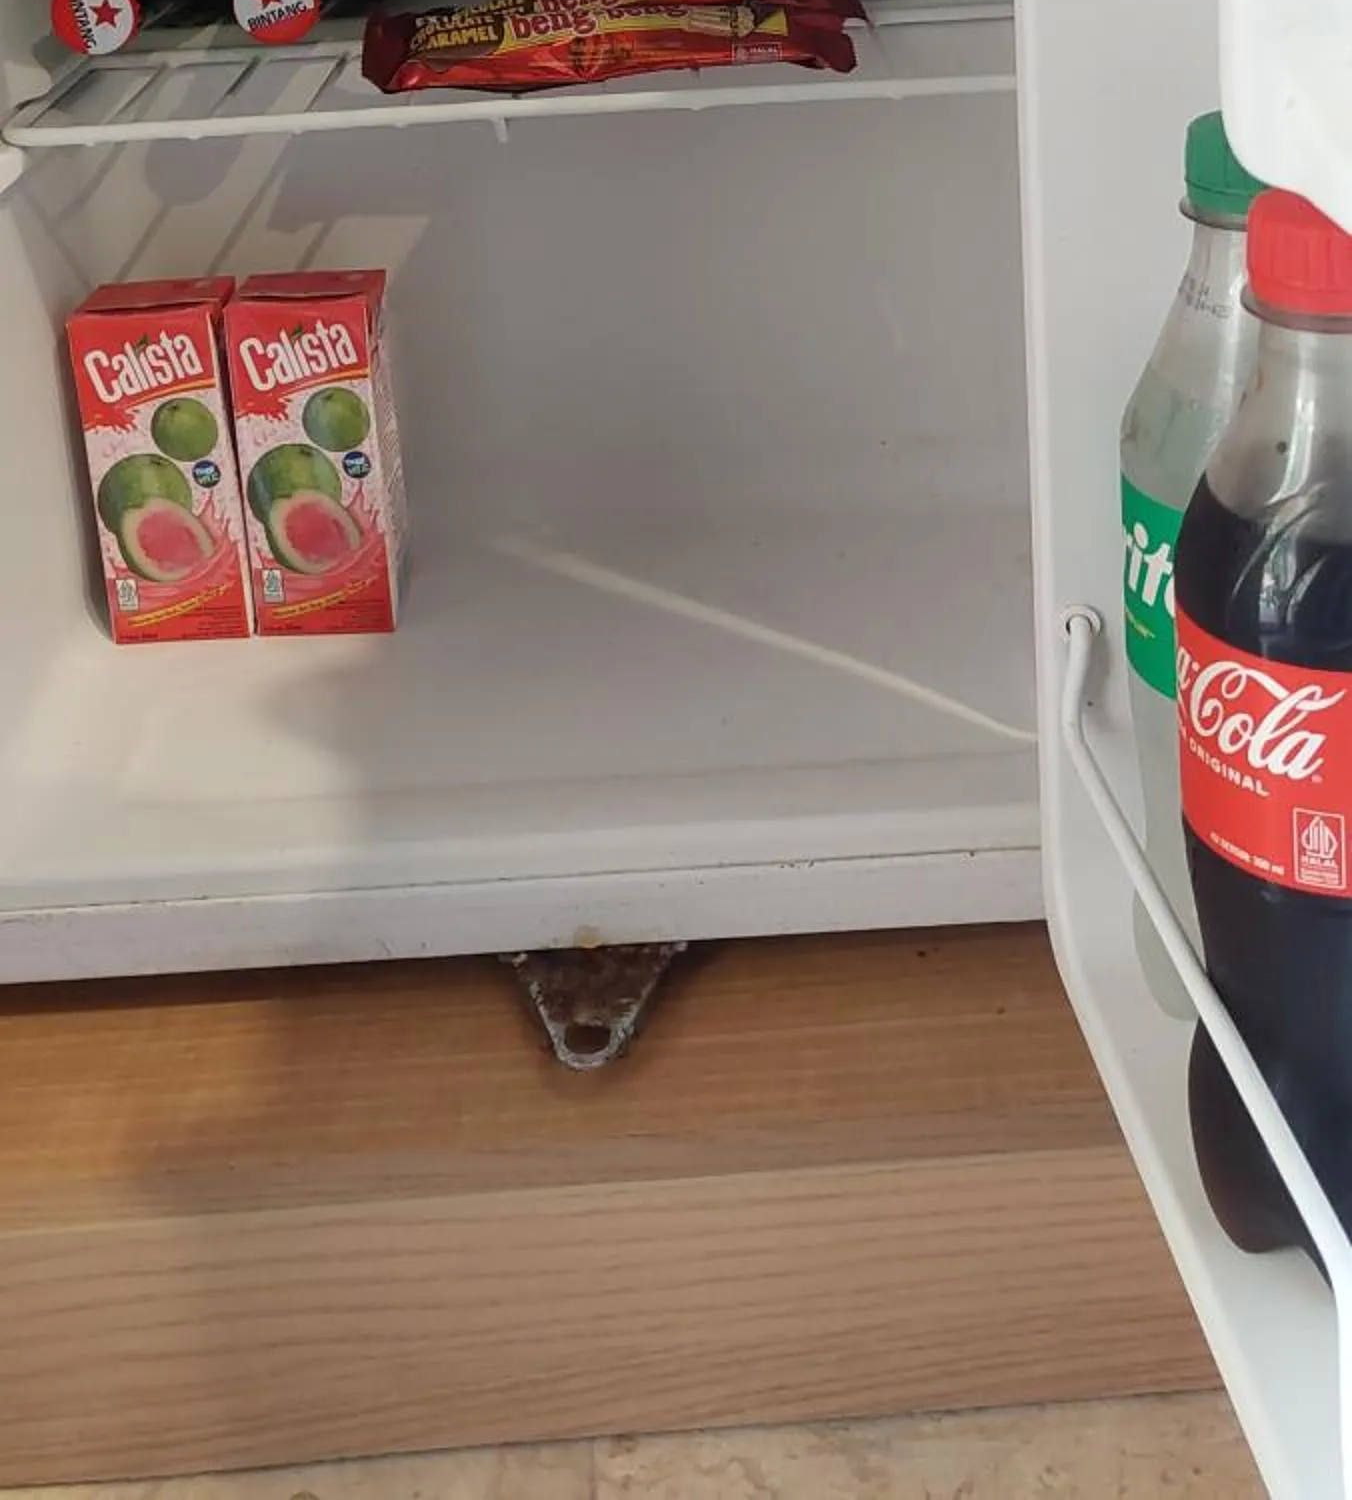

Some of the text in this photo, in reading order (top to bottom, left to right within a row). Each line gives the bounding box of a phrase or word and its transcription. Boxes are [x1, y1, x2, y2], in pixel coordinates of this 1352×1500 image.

[246, 0, 308, 31] BINTANG
[84, 329, 204, 404] Calista
[240, 319, 358, 392] Calista
[1189, 737, 1271, 798] ORIGINAL
